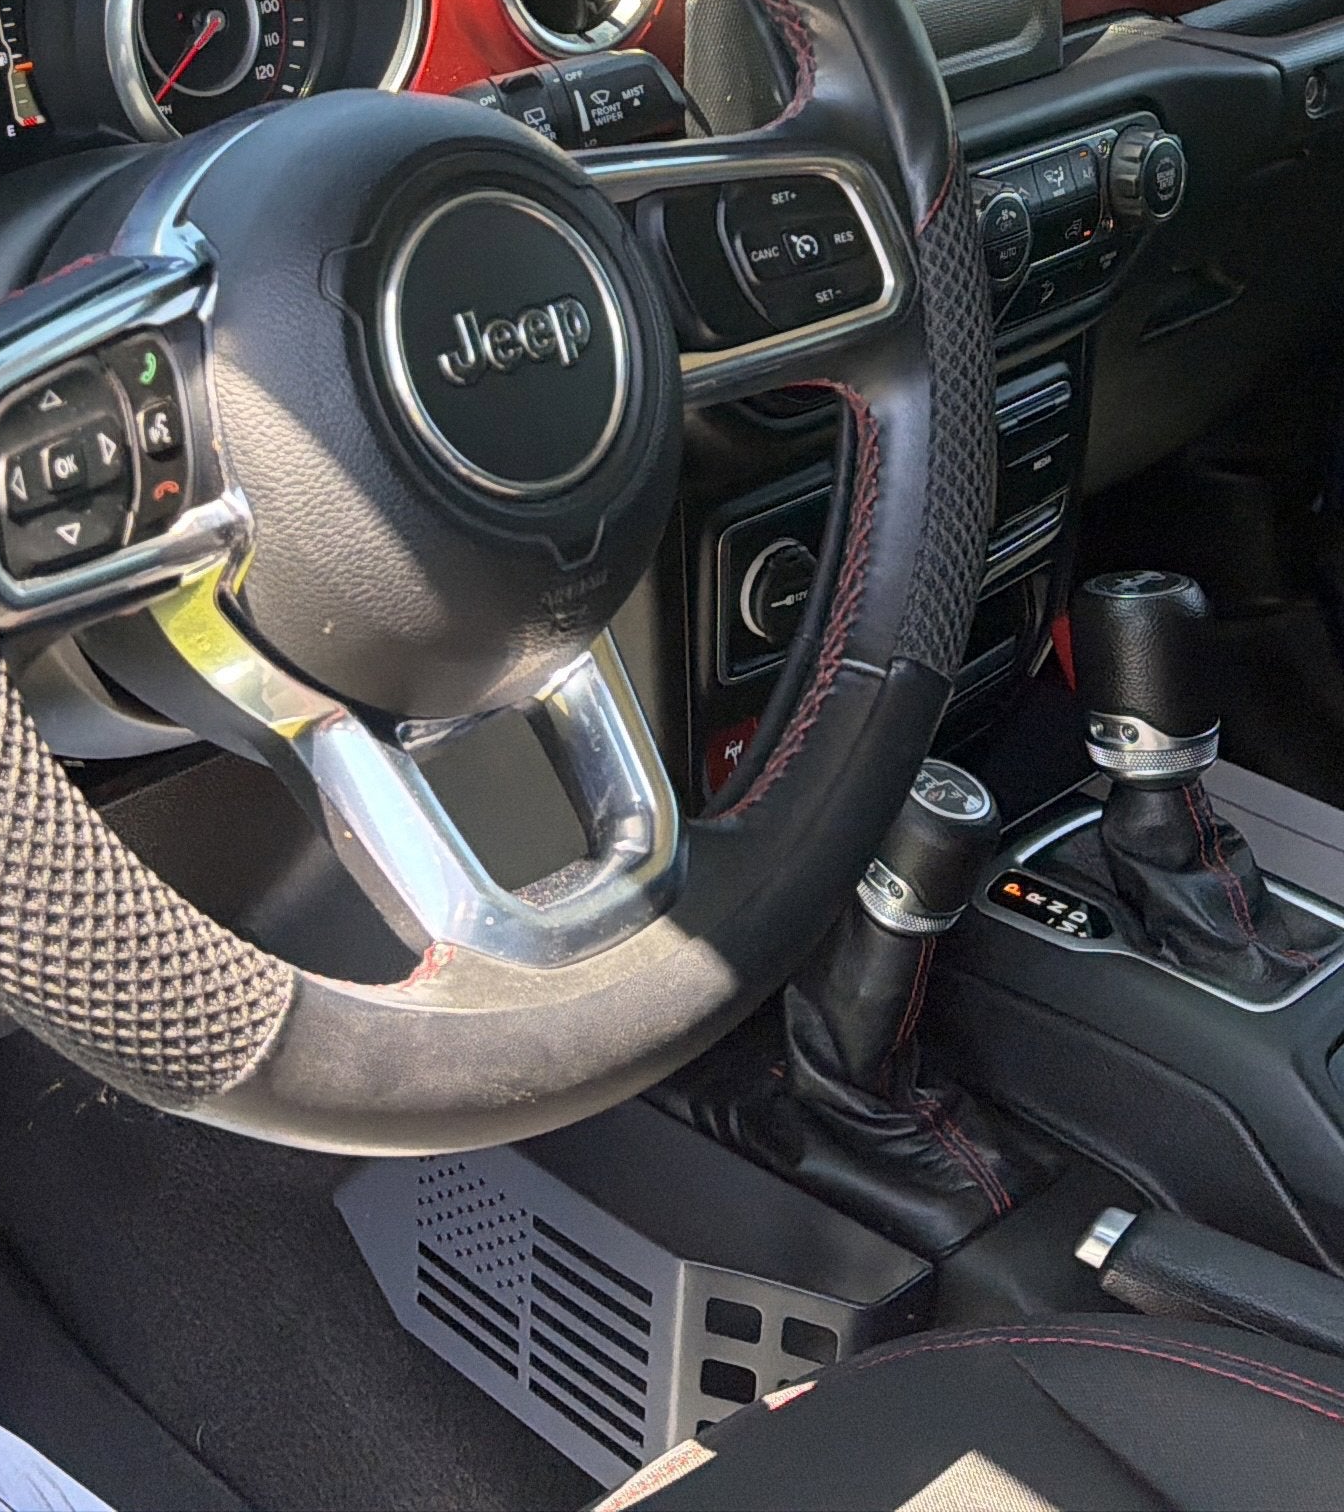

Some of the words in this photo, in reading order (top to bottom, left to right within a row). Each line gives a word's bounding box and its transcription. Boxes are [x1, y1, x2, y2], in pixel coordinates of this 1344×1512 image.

[264, 32, 280, 48] 110
[255, 63, 275, 81] 120
[565, 70, 583, 82] OFF
[621, 84, 645, 100] MIST
[480, 94, 497, 107] ON
[591, 101, 622, 119] FRONT
[594, 111, 624, 127] WIPER
[6, 124, 17, 138] E
[833, 230, 855, 245] RES
[751, 246, 780, 262] CANC
[999, 246, 1017, 261] AUTO
[439, 295, 591, 386] Jeep
[54, 454, 79, 479] OK
[1003, 882, 1022, 897] P
[1025, 892, 1047, 905] R
[1067, 910, 1088, 924] D
